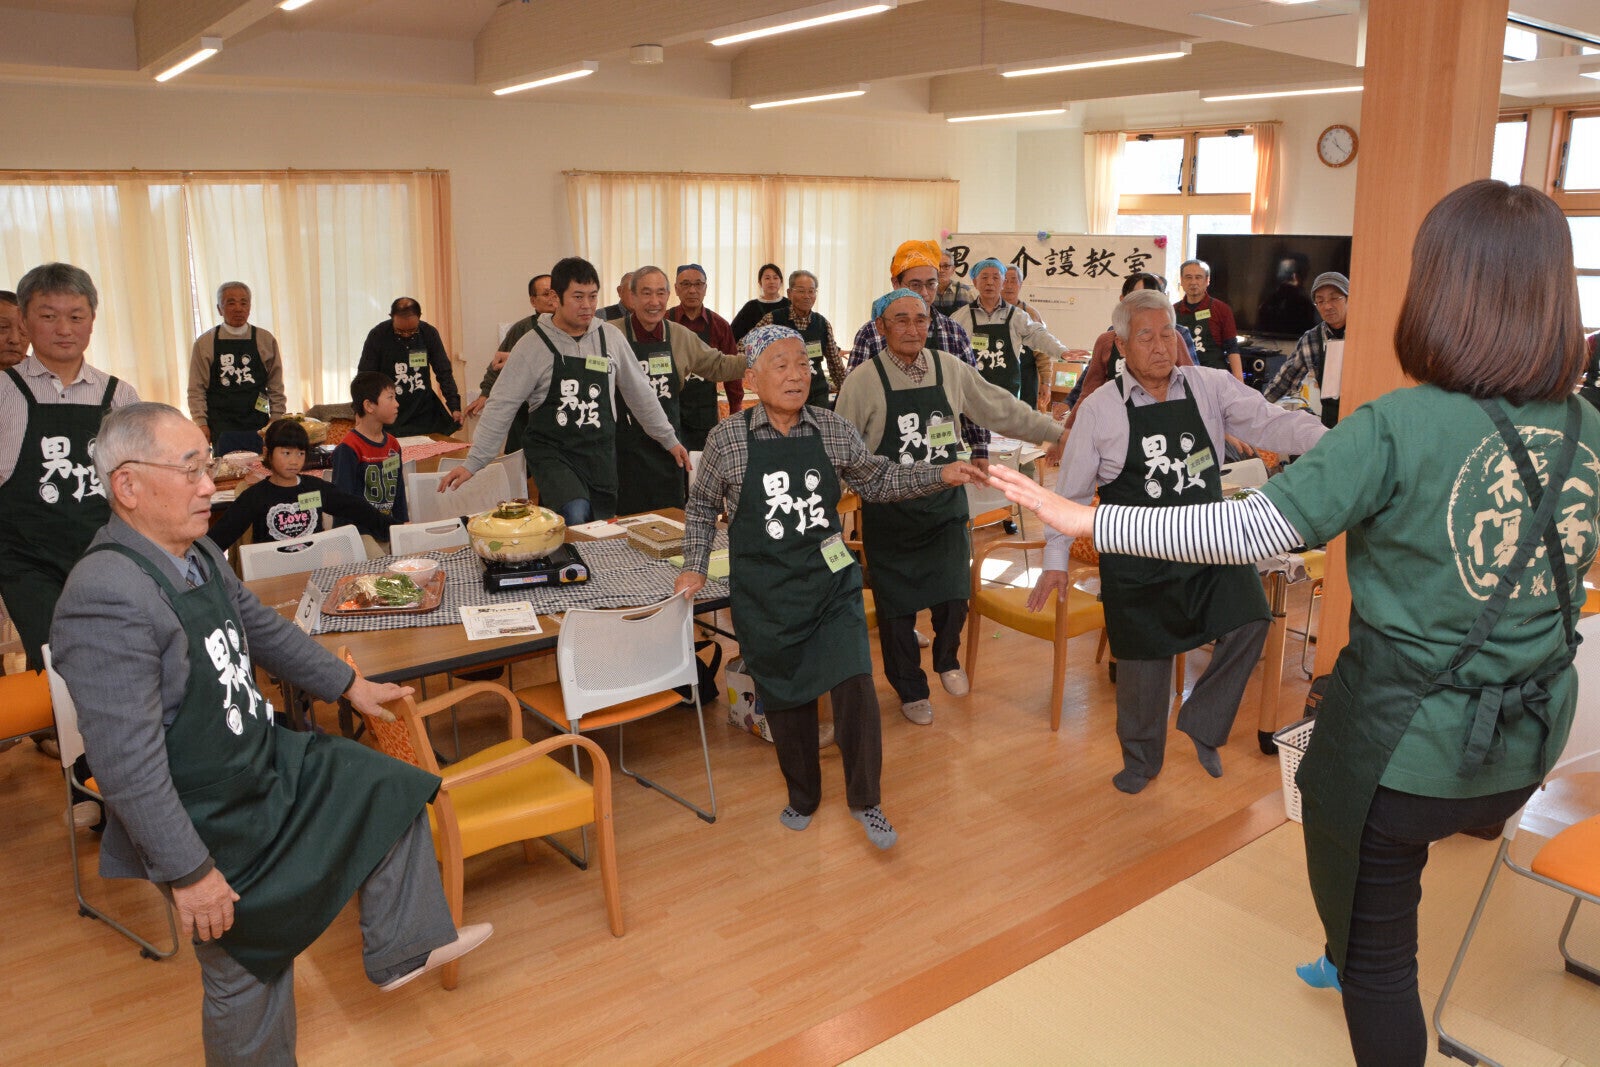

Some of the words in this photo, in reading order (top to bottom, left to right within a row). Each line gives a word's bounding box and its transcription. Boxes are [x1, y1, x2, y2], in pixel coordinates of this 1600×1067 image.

[946, 245, 1152, 281] 男介護教室
[557, 378, 601, 429] 男技
[277, 512, 308, 525] Love
[762, 470, 830, 535] 男技
